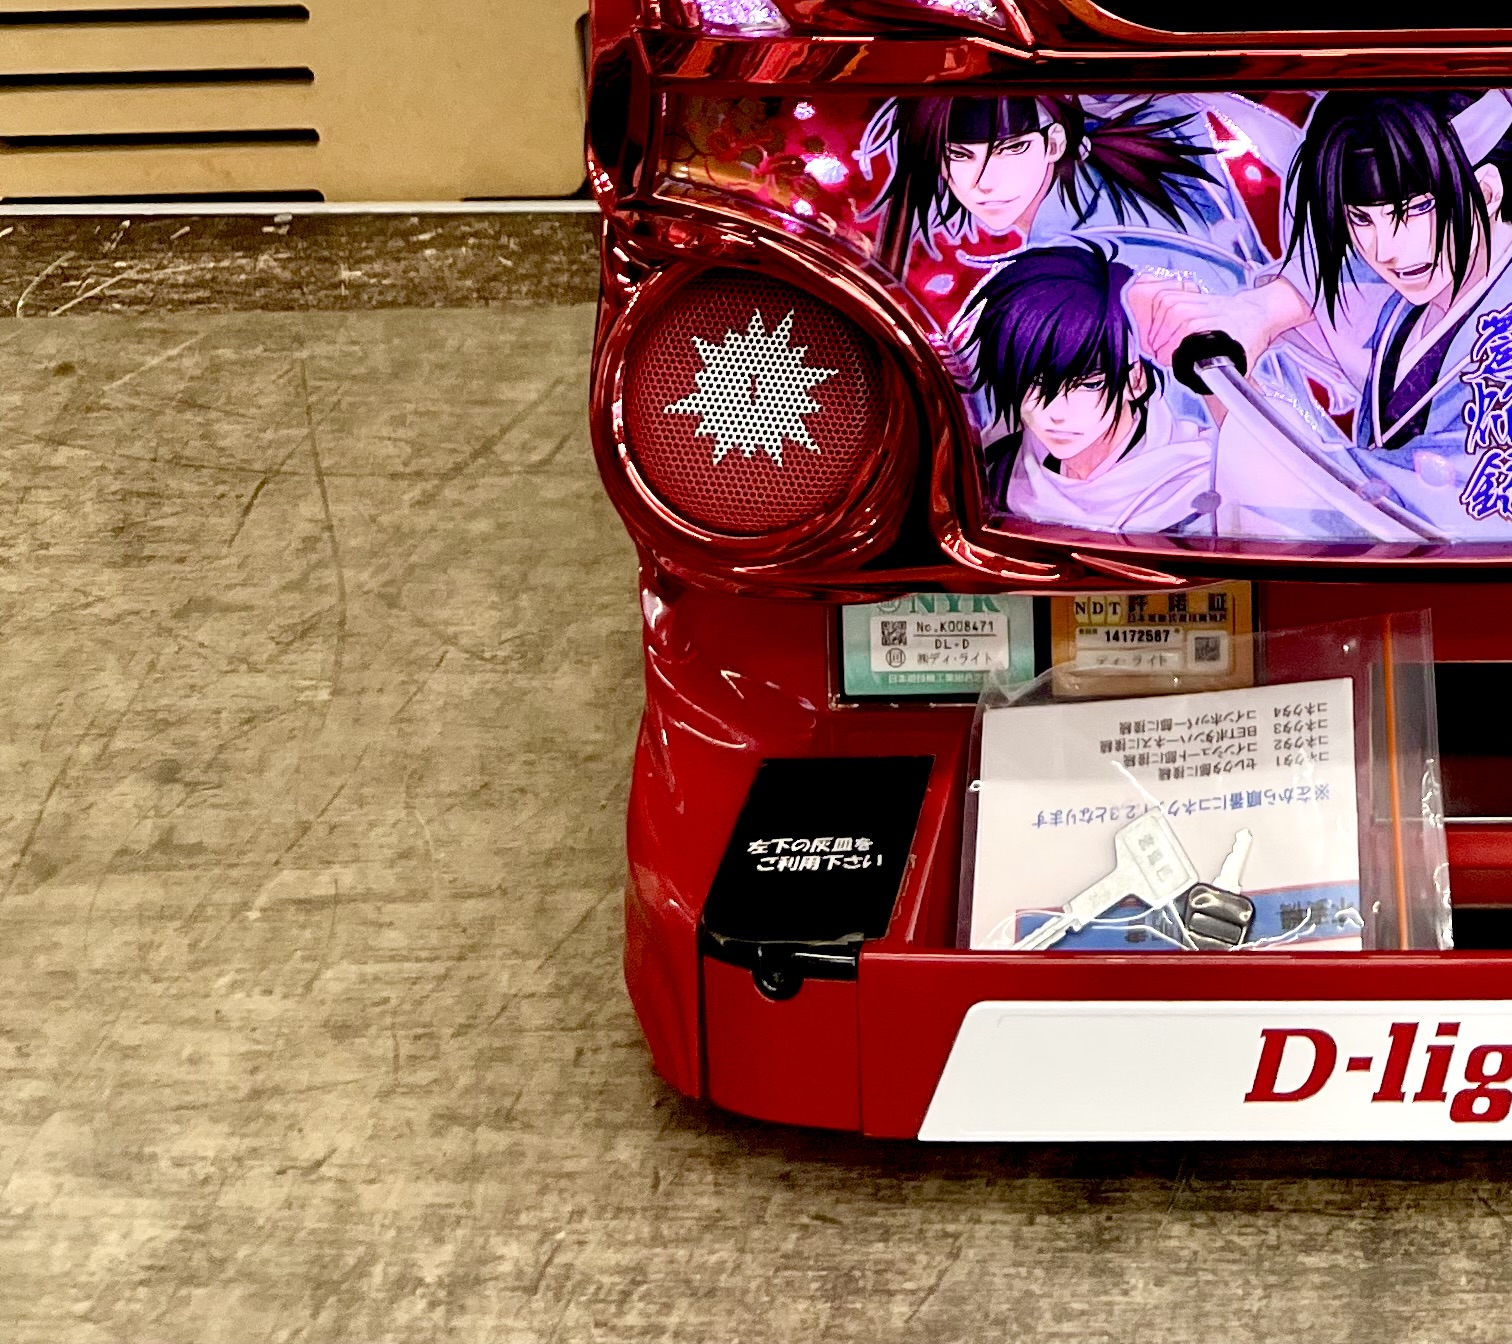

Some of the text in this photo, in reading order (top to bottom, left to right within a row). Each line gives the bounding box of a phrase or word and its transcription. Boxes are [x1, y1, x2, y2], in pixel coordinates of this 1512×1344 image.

[1075, 601, 1122, 616] NDT
[747, 837, 874, 854] 左下の灰皿を
[756, 854, 883, 872] ご利用下さい
